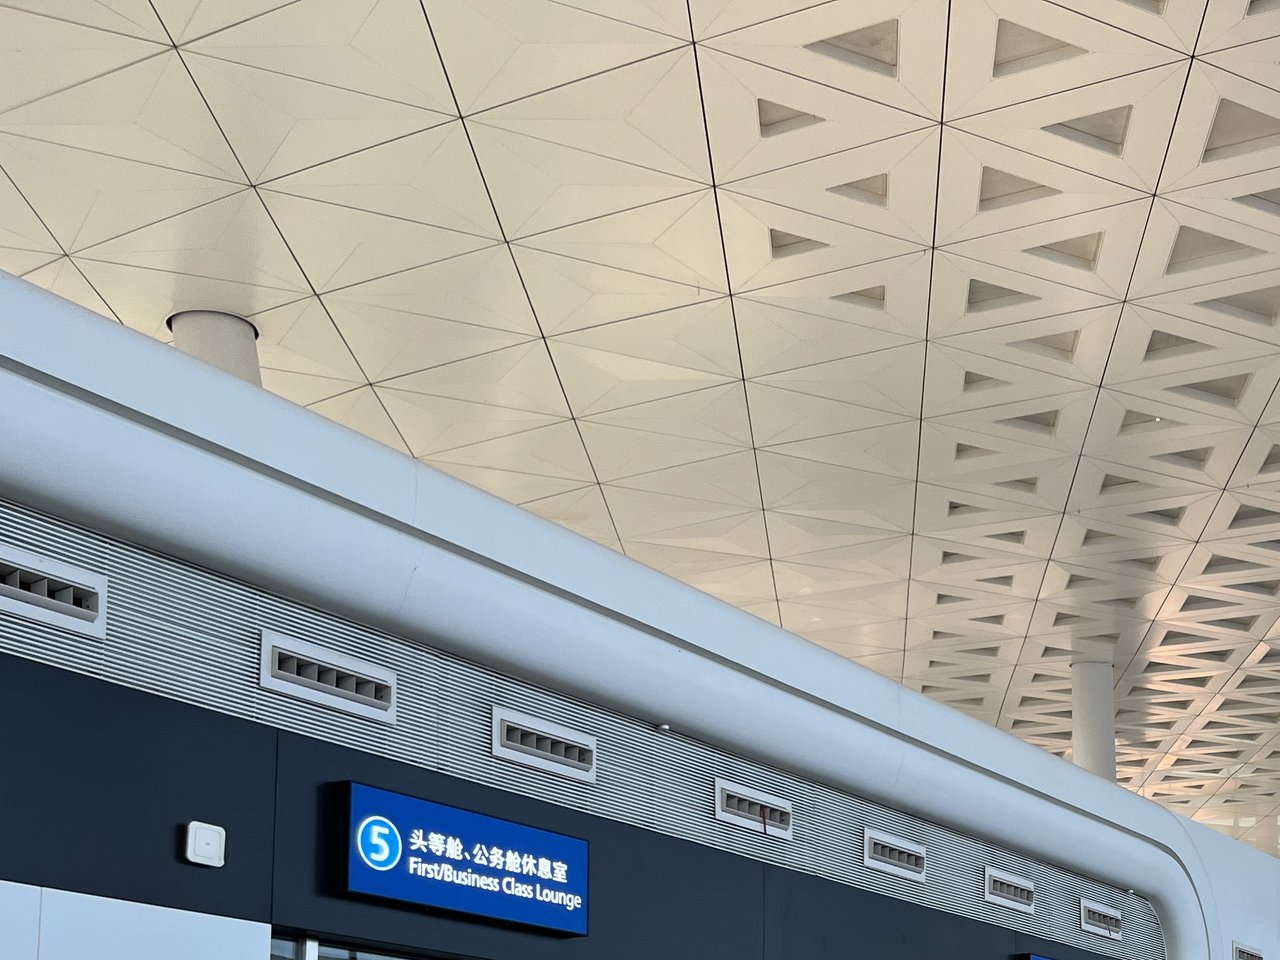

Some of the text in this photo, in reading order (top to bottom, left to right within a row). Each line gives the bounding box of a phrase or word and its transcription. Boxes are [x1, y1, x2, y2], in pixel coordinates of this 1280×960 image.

[369, 824, 391, 862] 5
[409, 829, 568, 883] 头等舱、公务舱休息室
[409, 857, 582, 911] First/Business Class Lounge
